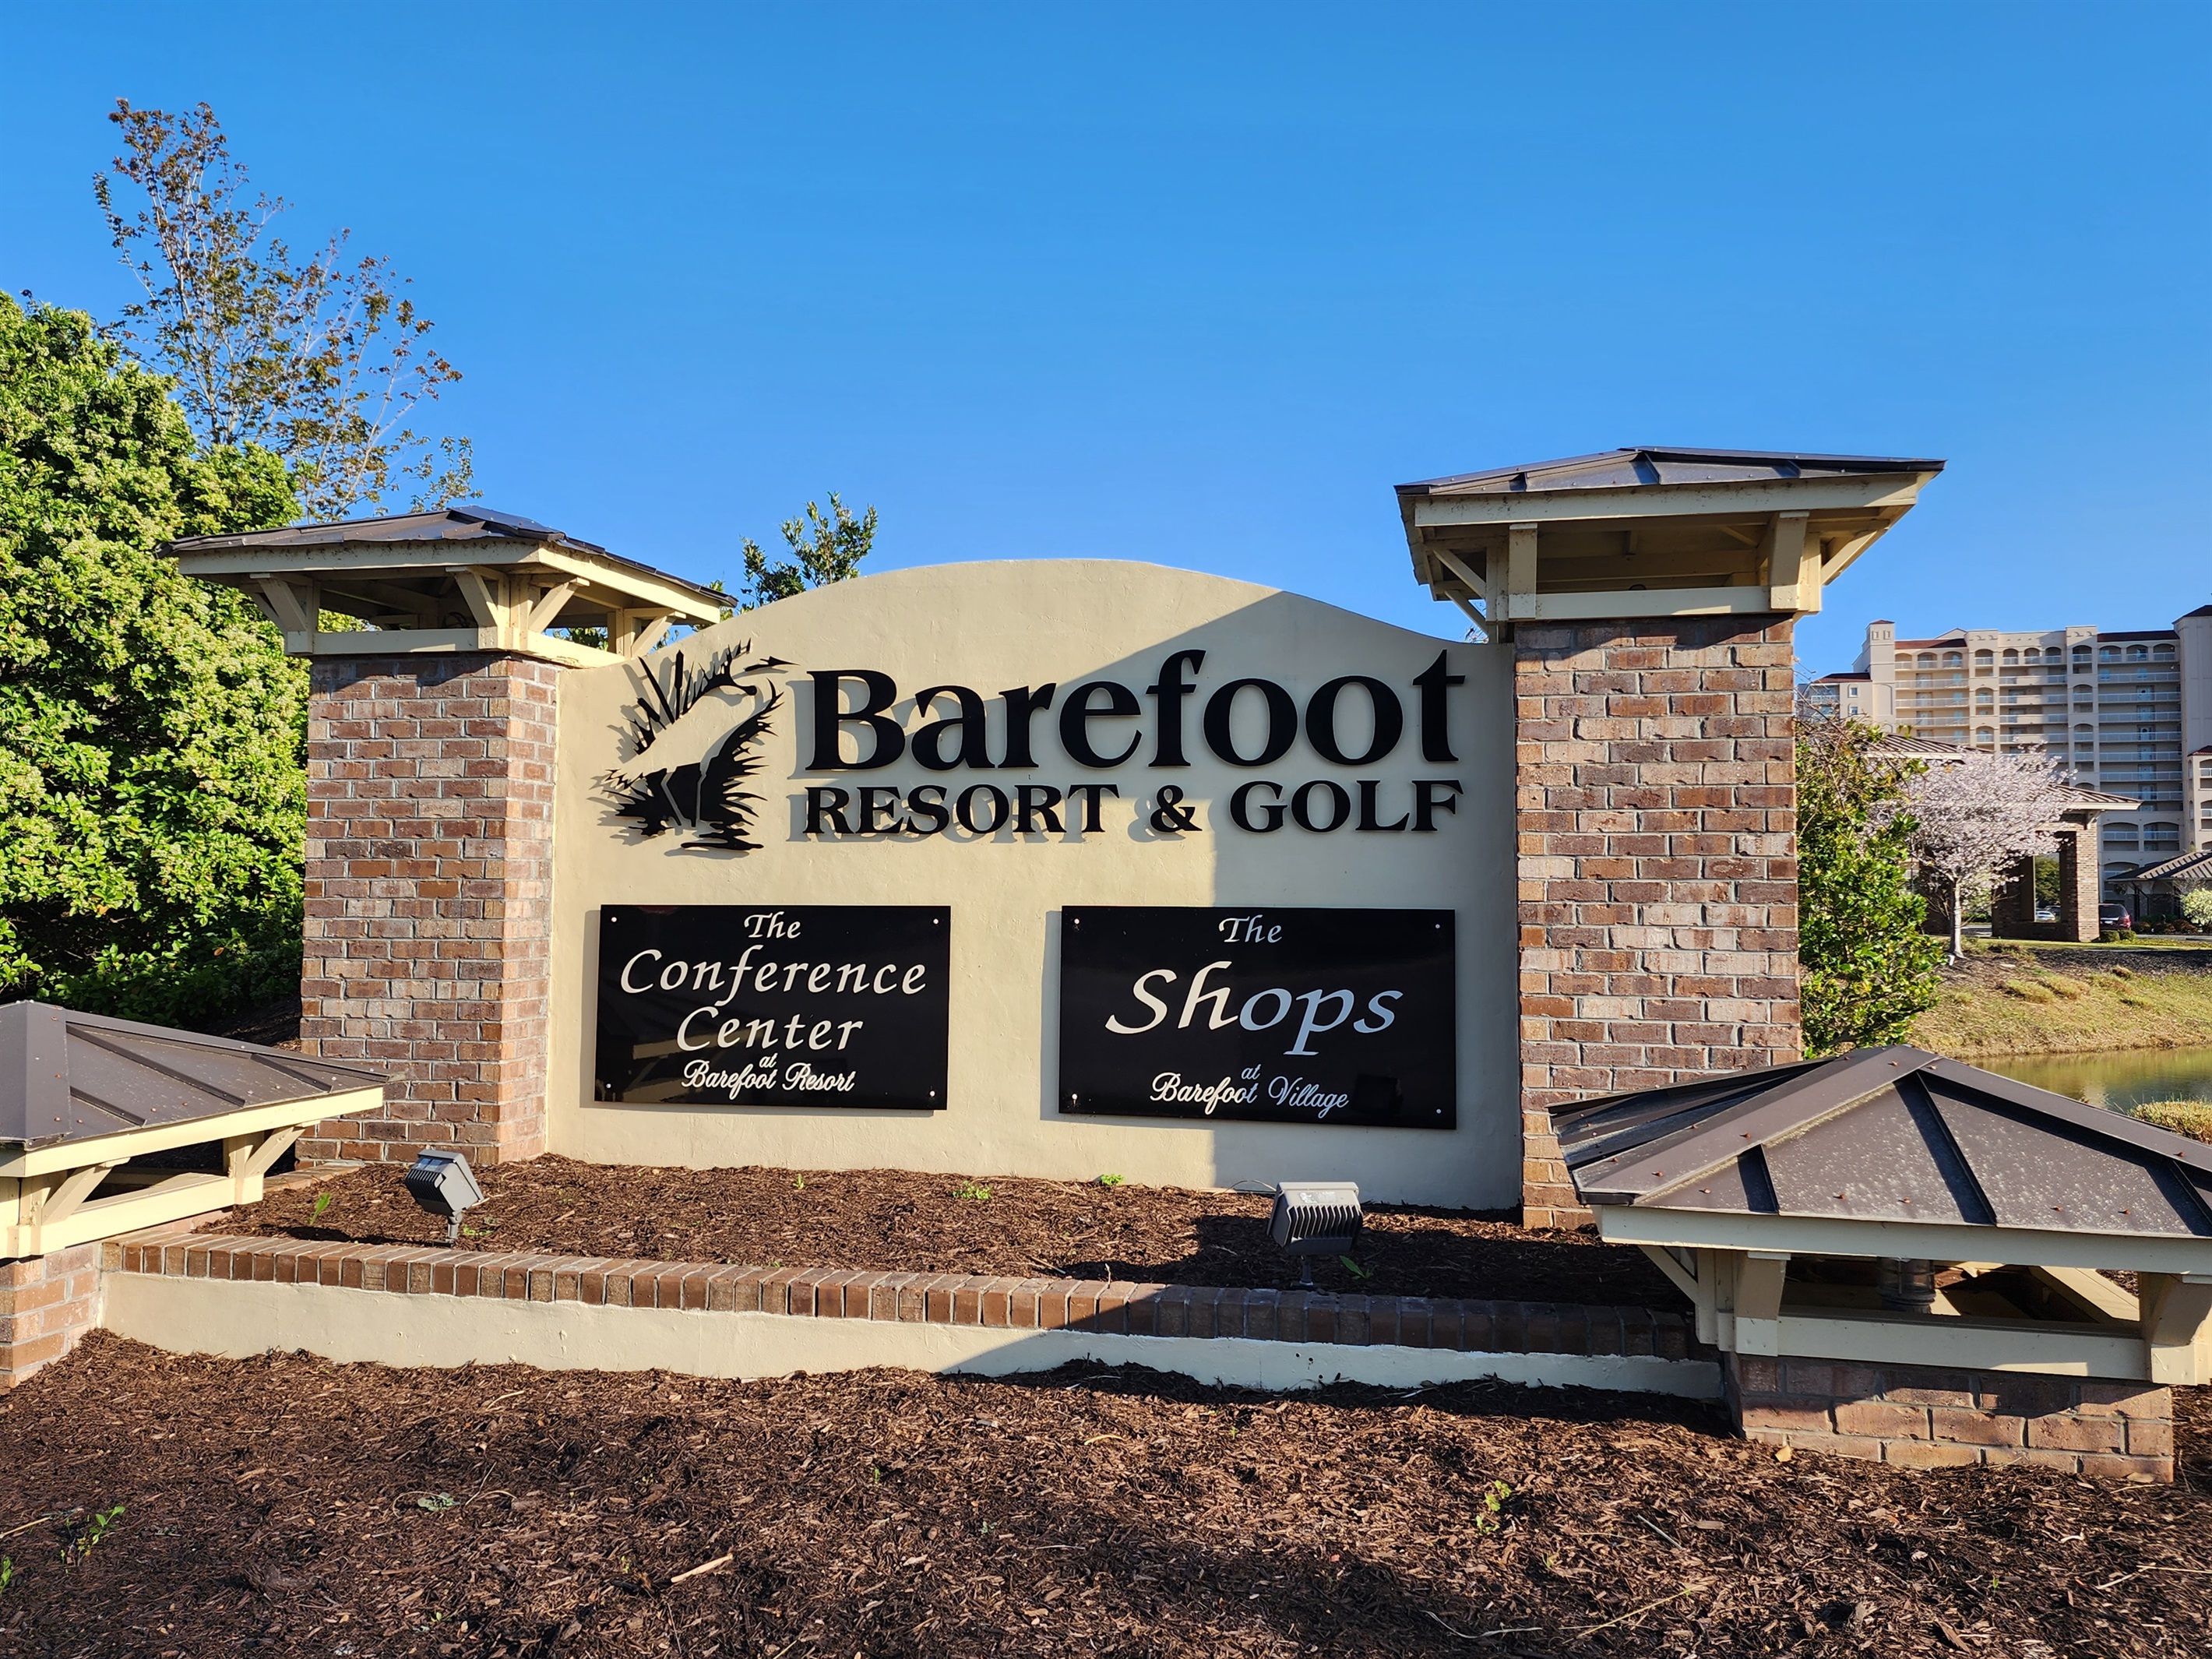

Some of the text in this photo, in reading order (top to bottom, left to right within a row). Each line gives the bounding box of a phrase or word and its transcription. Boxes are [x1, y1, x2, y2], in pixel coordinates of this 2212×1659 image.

[805, 649, 1466, 771] Barefoot
[802, 779, 1464, 834] RESORT & GOLF
[744, 911, 801, 939] The
[1218, 914, 1283, 943] The
[621, 944, 927, 1007] Conference
[677, 1006, 864, 1051] Center
[1104, 960, 1404, 1056] Shops
[681, 1059, 857, 1100] Barefoot Resort
[759, 1052, 777, 1069] at
[1241, 1064, 1261, 1080] at
[1150, 1072, 1349, 1119] Barefoot Village
